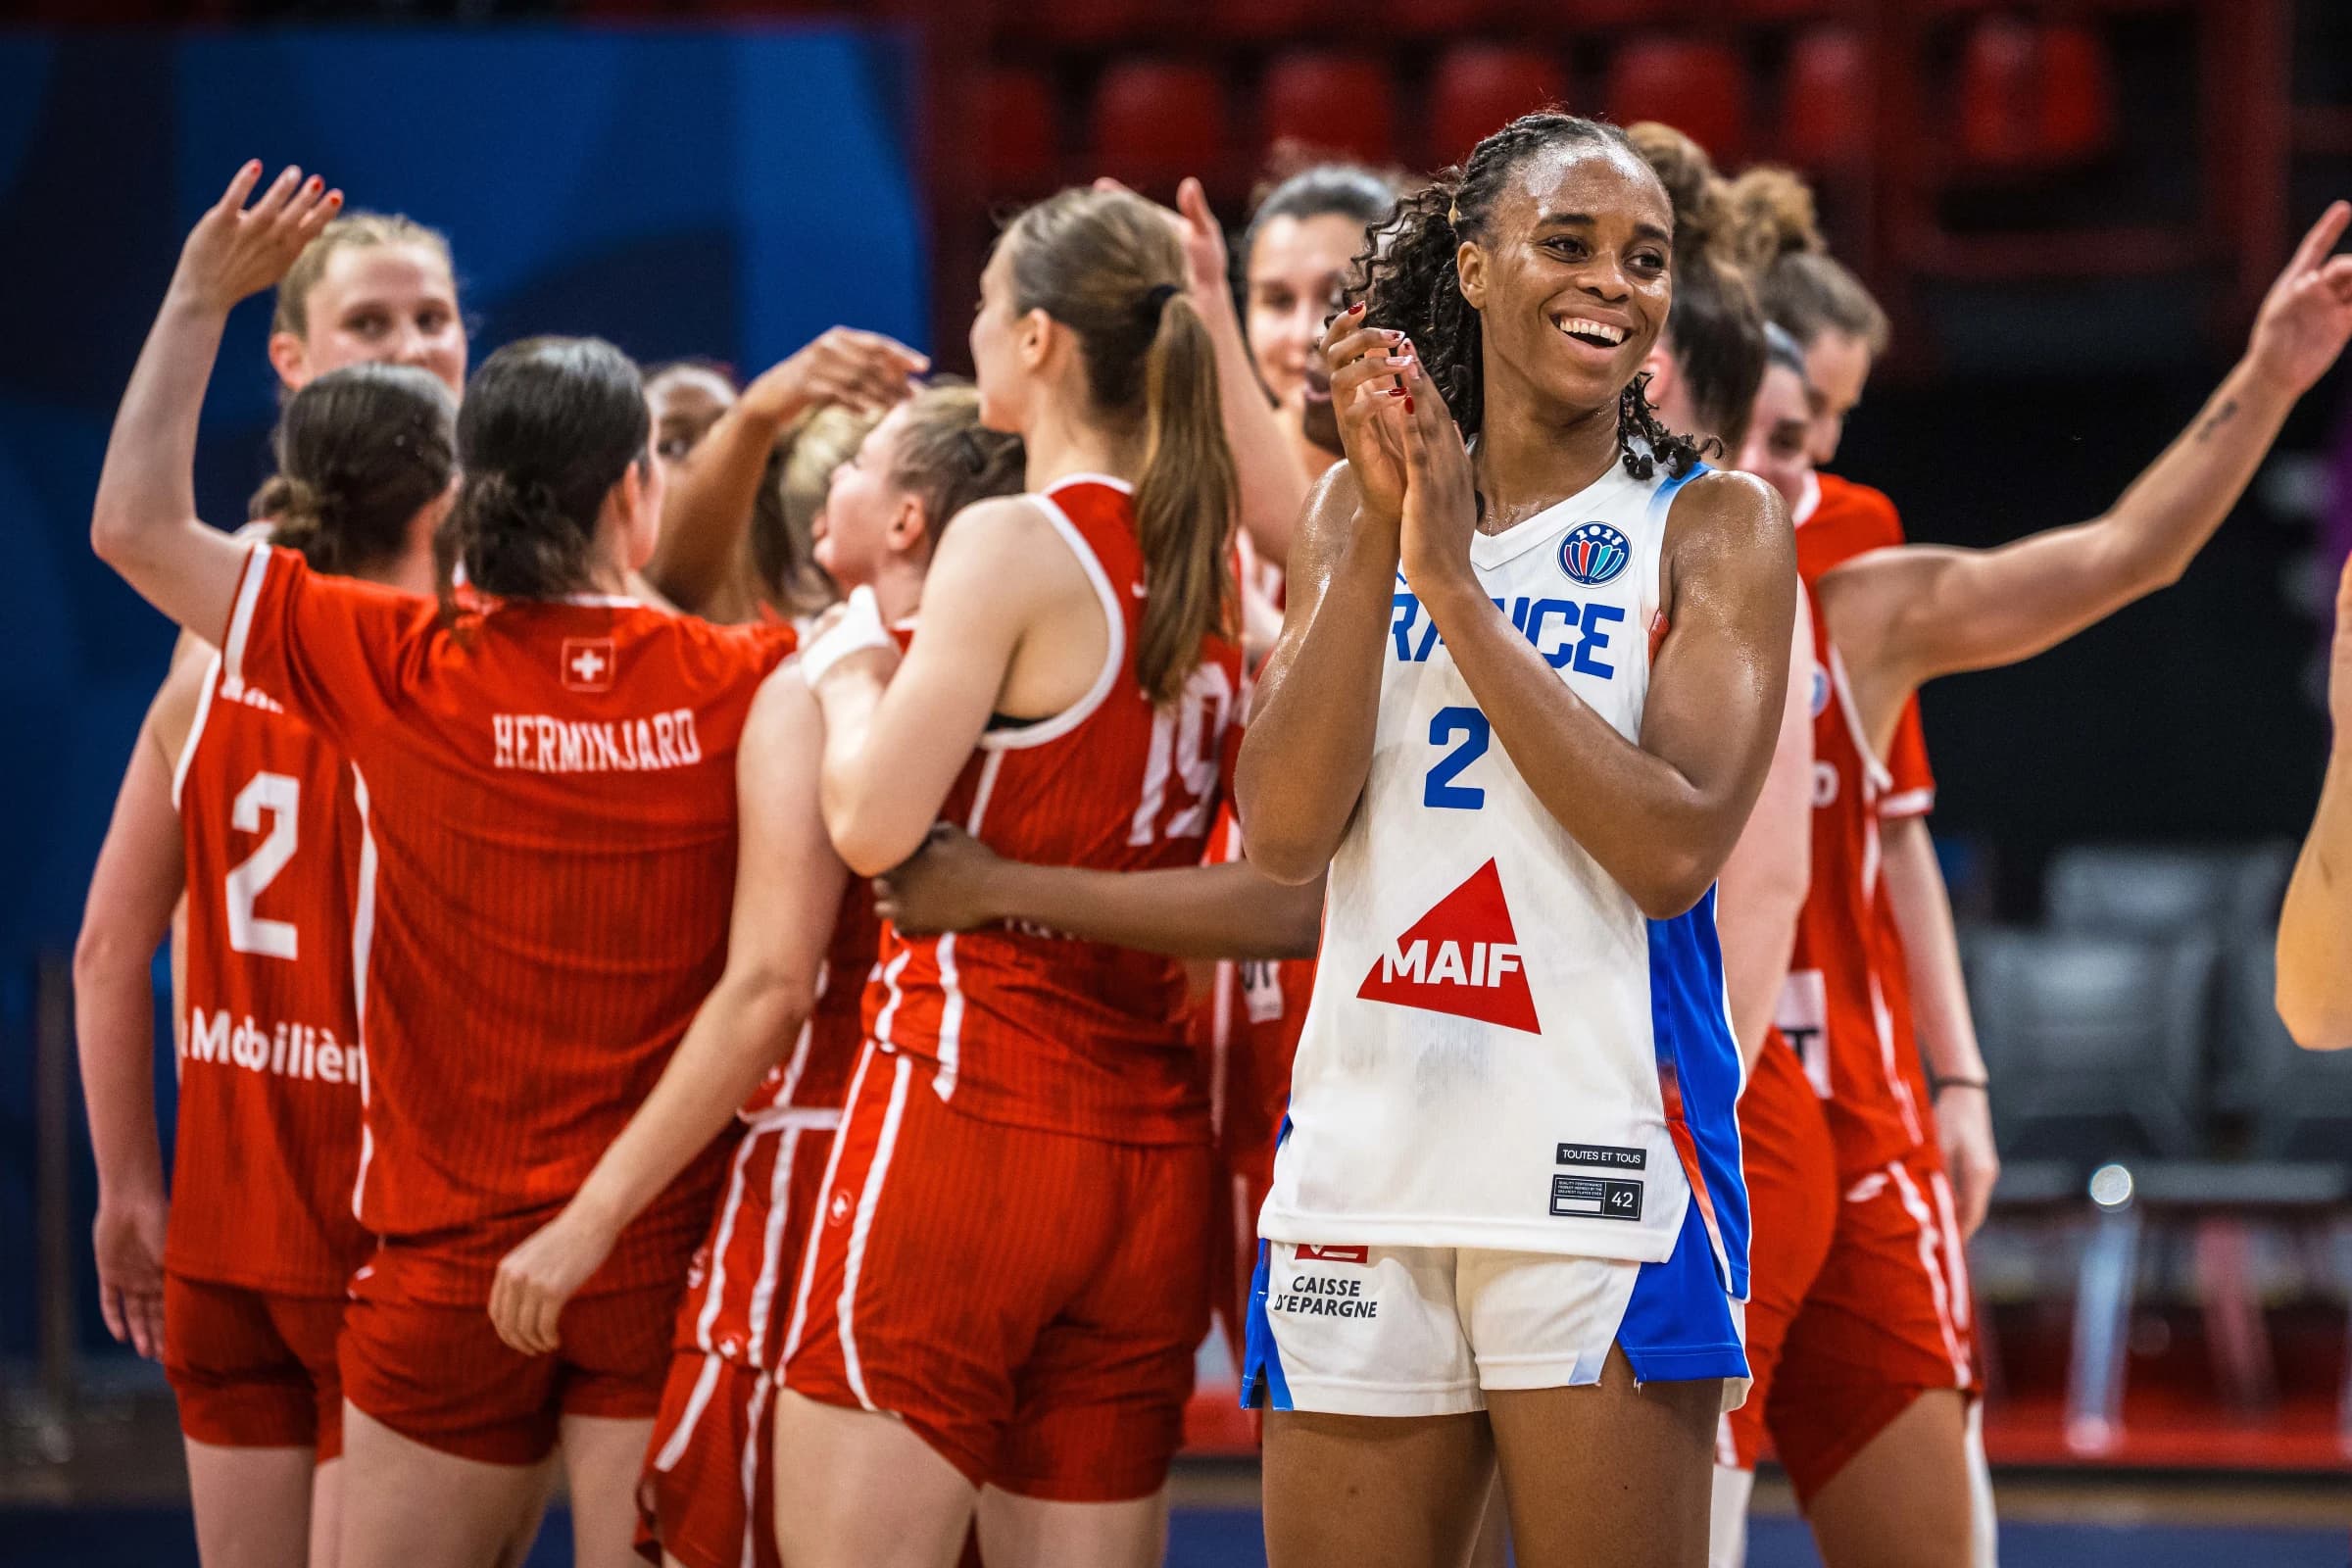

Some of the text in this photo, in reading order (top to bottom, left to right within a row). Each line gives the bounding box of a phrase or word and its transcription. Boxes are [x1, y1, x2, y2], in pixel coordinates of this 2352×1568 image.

[1576, 525, 1624, 546] 2025
[493, 708, 702, 773] HERMINJARD
[1128, 662, 1231, 847] 19
[1424, 707, 1491, 810] 2
[225, 770, 300, 960] 2
[1382, 939, 1522, 988] MAIF
[1562, 1149, 1641, 1164] TOUTES ET TOUS
[1611, 1191, 1634, 1208] 42
[1292, 1275, 1361, 1298] CAISSE
